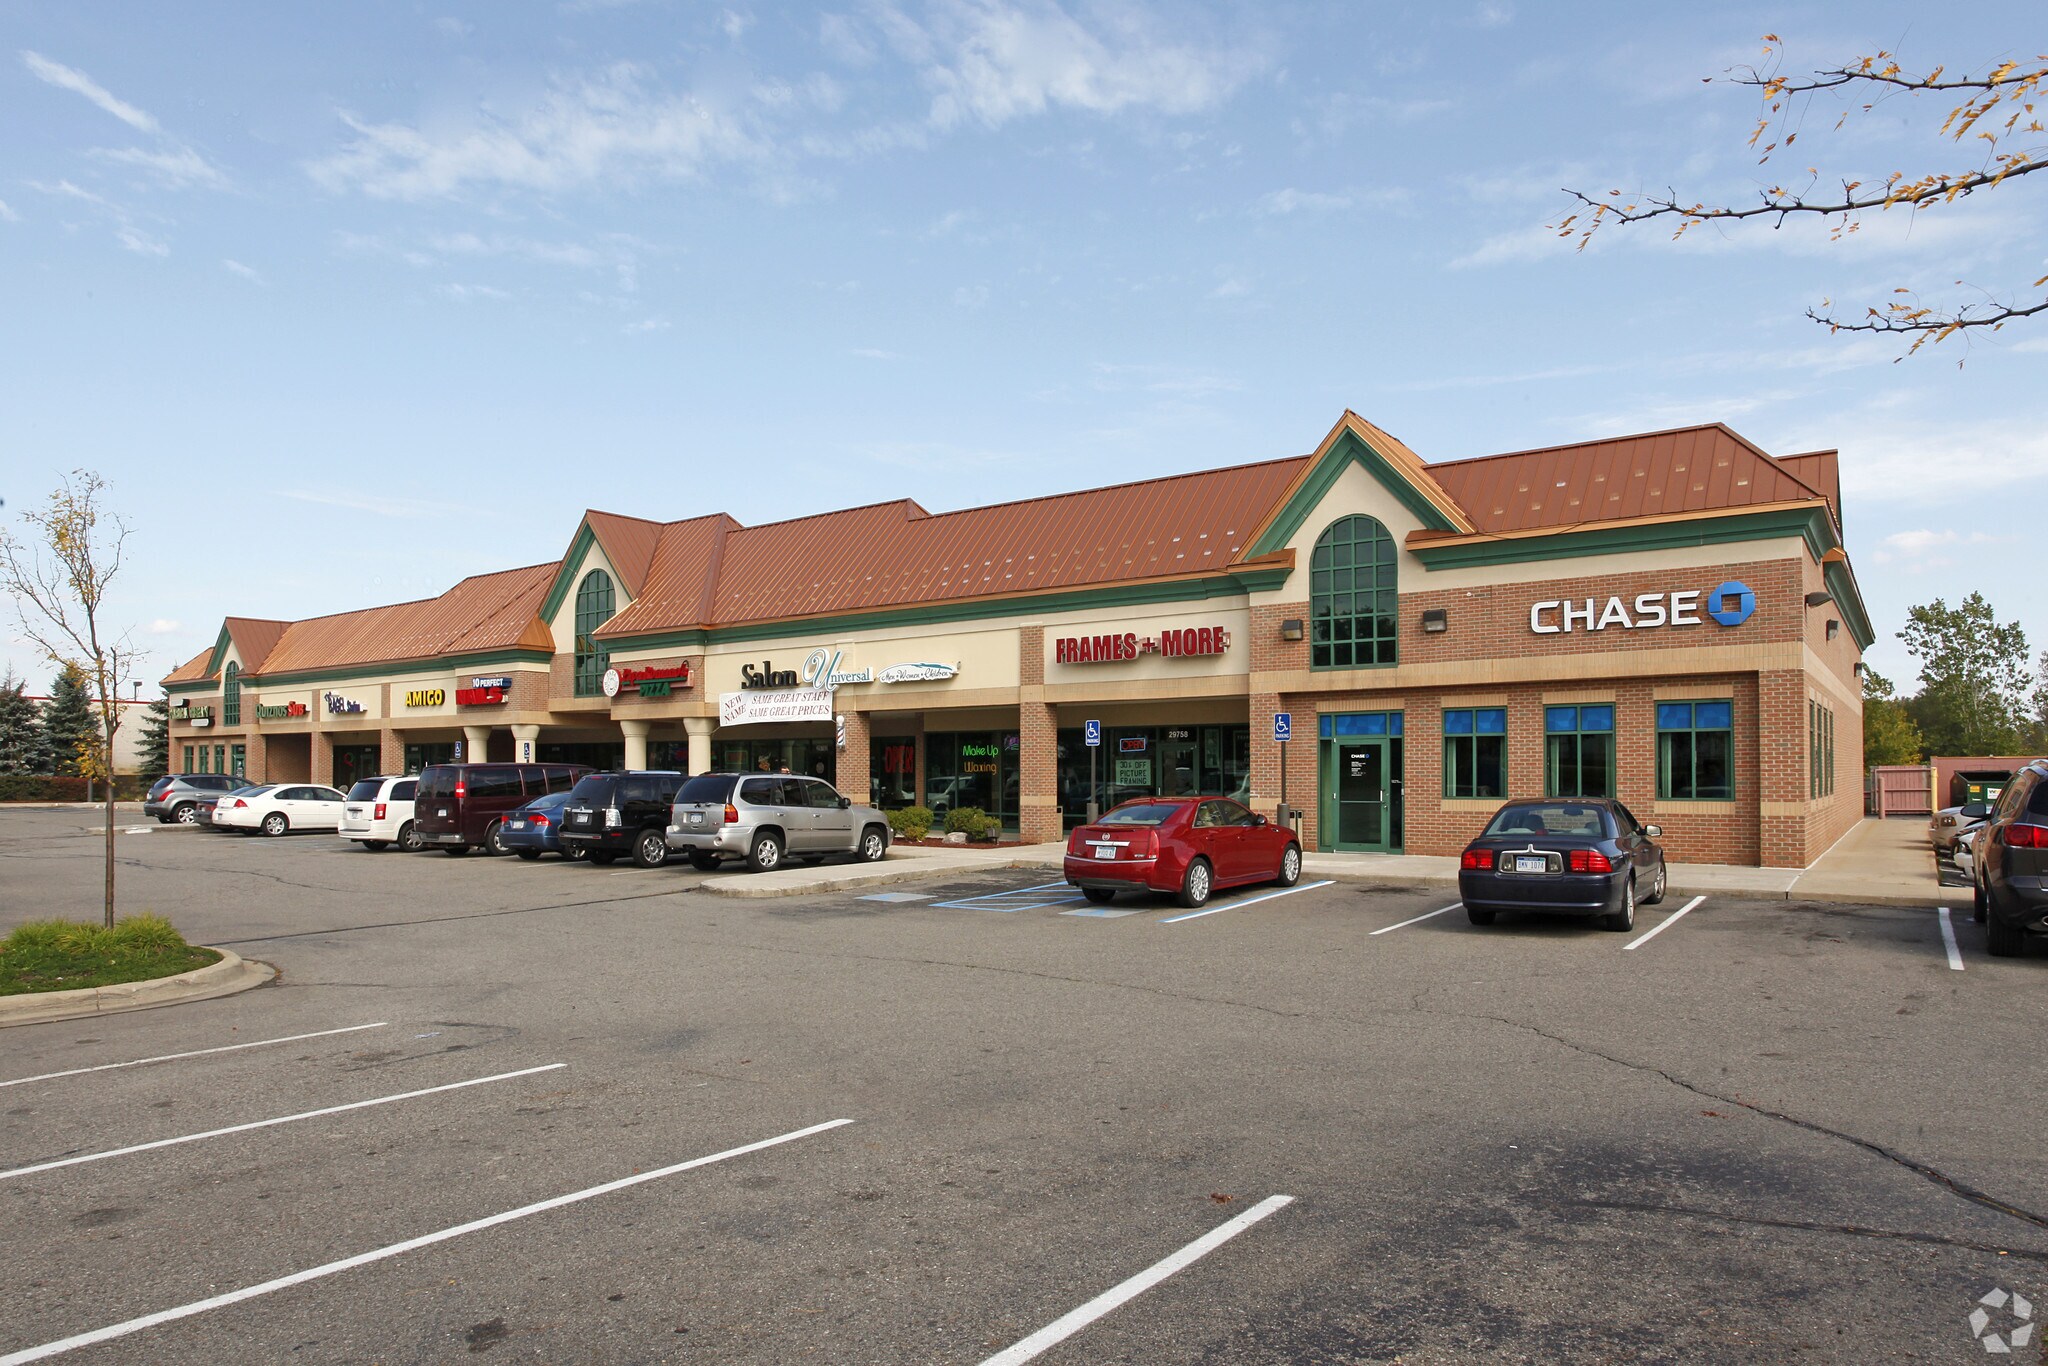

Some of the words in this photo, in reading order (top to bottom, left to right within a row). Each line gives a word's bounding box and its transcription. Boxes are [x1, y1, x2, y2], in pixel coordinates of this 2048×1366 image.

[1530, 590, 1702, 634] CHASE
[1055, 632, 1138, 664] FRAMES
[1160, 625, 1226, 657] MORE
[741, 660, 799, 689] Salon
[802, 648, 874, 691] Universal
[472, 678, 480, 688] 10
[480, 678, 504, 688] PERFECT
[640, 682, 671, 697] PIZZA
[405, 689, 444, 707] AMIGO
[724, 694, 743, 712] NEW
[752, 695, 773, 705] SAME
[774, 693, 801, 703] GREAT
[801, 691, 829, 702] STAFF
[724, 703, 747, 724] NAME
[749, 708, 768, 718] SAME
[769, 706, 797, 716] GREAT
[797, 704, 830, 716] PRICES
[962, 745, 986, 757] Make
[987, 745, 999, 758] Up
[1122, 741, 1144, 750] OPEN
[884, 745, 914, 774] OPEN
[1135, 761, 1147, 769] OFF
[963, 762, 997, 775] Waxing
[1120, 777, 1147, 785] FRAMING
[1531, 861, 1544, 869] 1074
